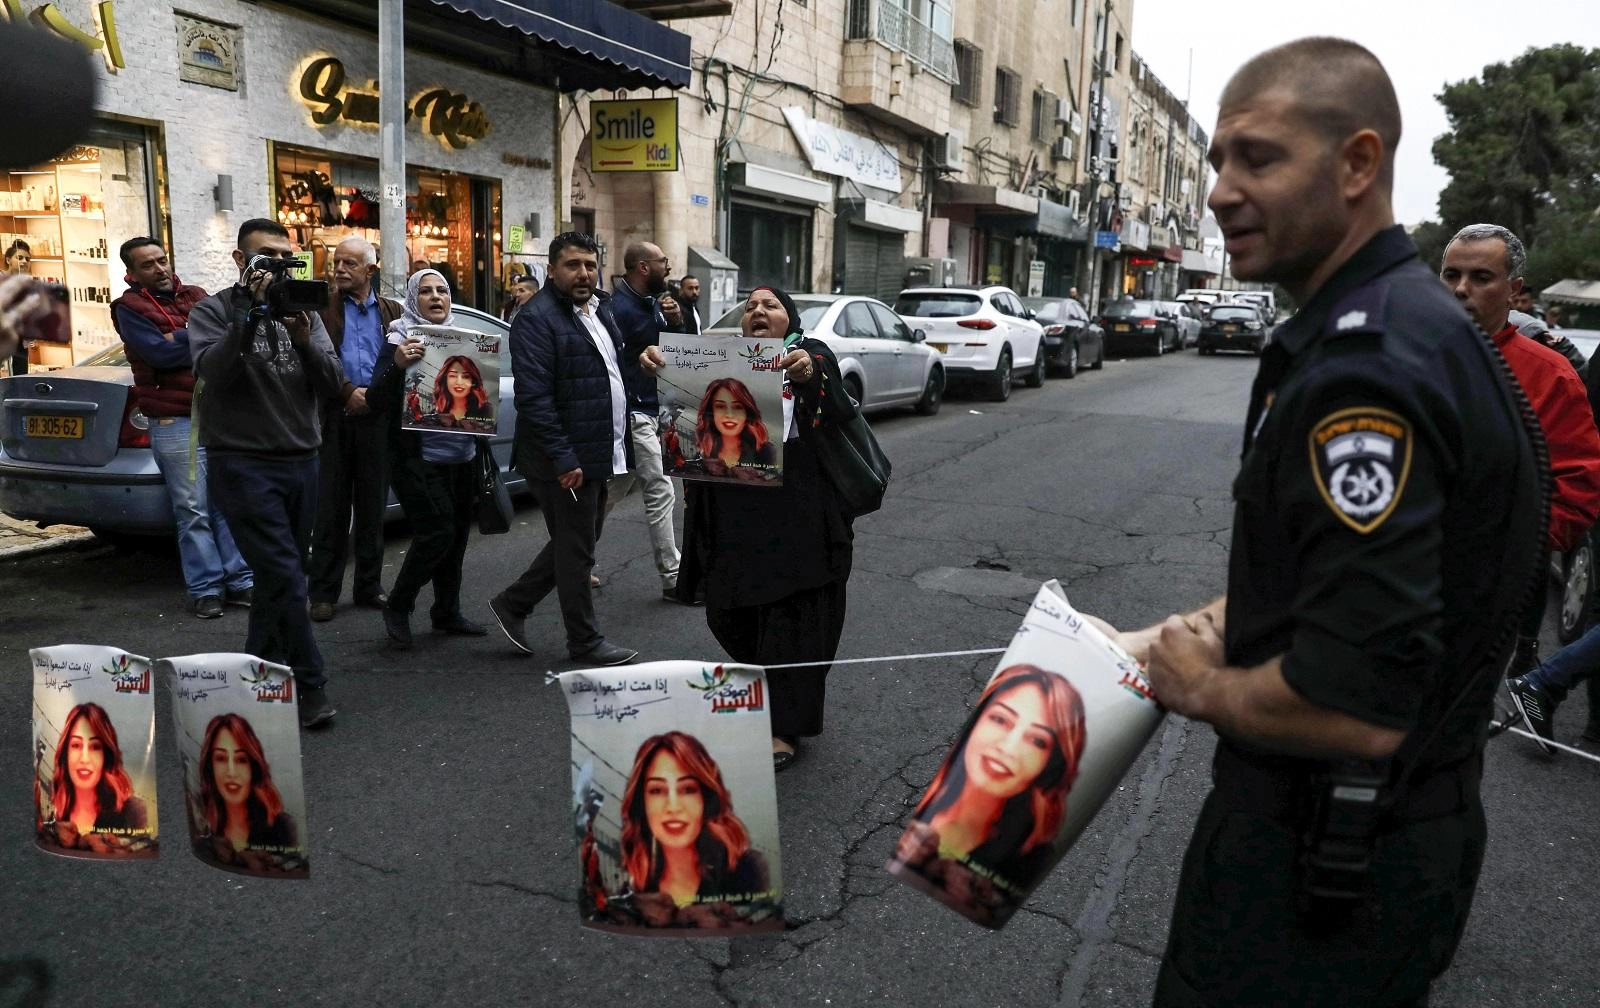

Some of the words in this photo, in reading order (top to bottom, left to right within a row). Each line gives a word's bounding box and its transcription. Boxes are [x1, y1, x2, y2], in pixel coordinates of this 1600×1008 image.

[595, 109, 655, 140] Smile
[718, 349, 726, 358] إذا
[1064, 614, 1083, 634] إذا
[83, 664, 92, 674] إذا
[600, 680, 626, 696] اشبعوا
[630, 680, 652, 692] متت
[656, 679, 668, 694] إذا
